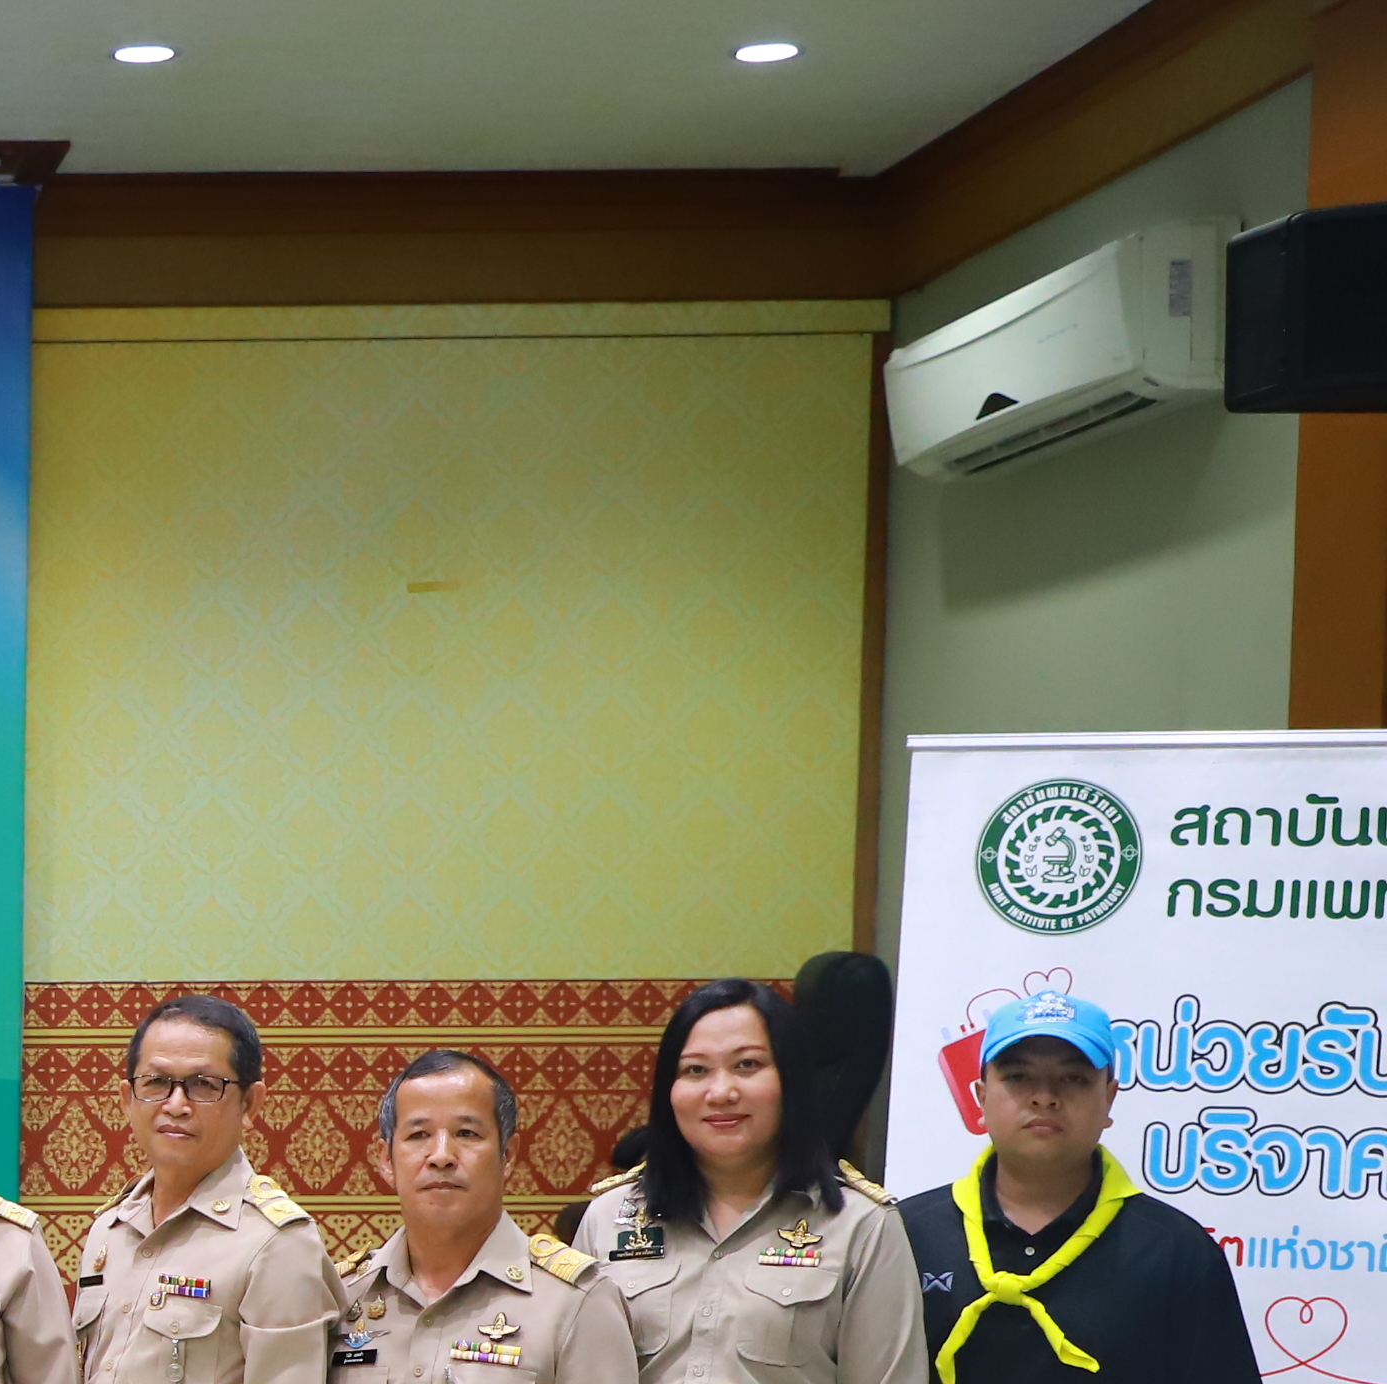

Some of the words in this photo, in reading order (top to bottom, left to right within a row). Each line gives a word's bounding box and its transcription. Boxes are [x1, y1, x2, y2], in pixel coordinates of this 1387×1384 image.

[1170, 793, 1387, 847] สถาบัน
[988, 882, 1010, 908] ARMY
[1006, 905, 1057, 929] INSTITUTE
[1060, 917, 1074, 929] OF
[1076, 883, 1127, 925] PATHOLOGY
